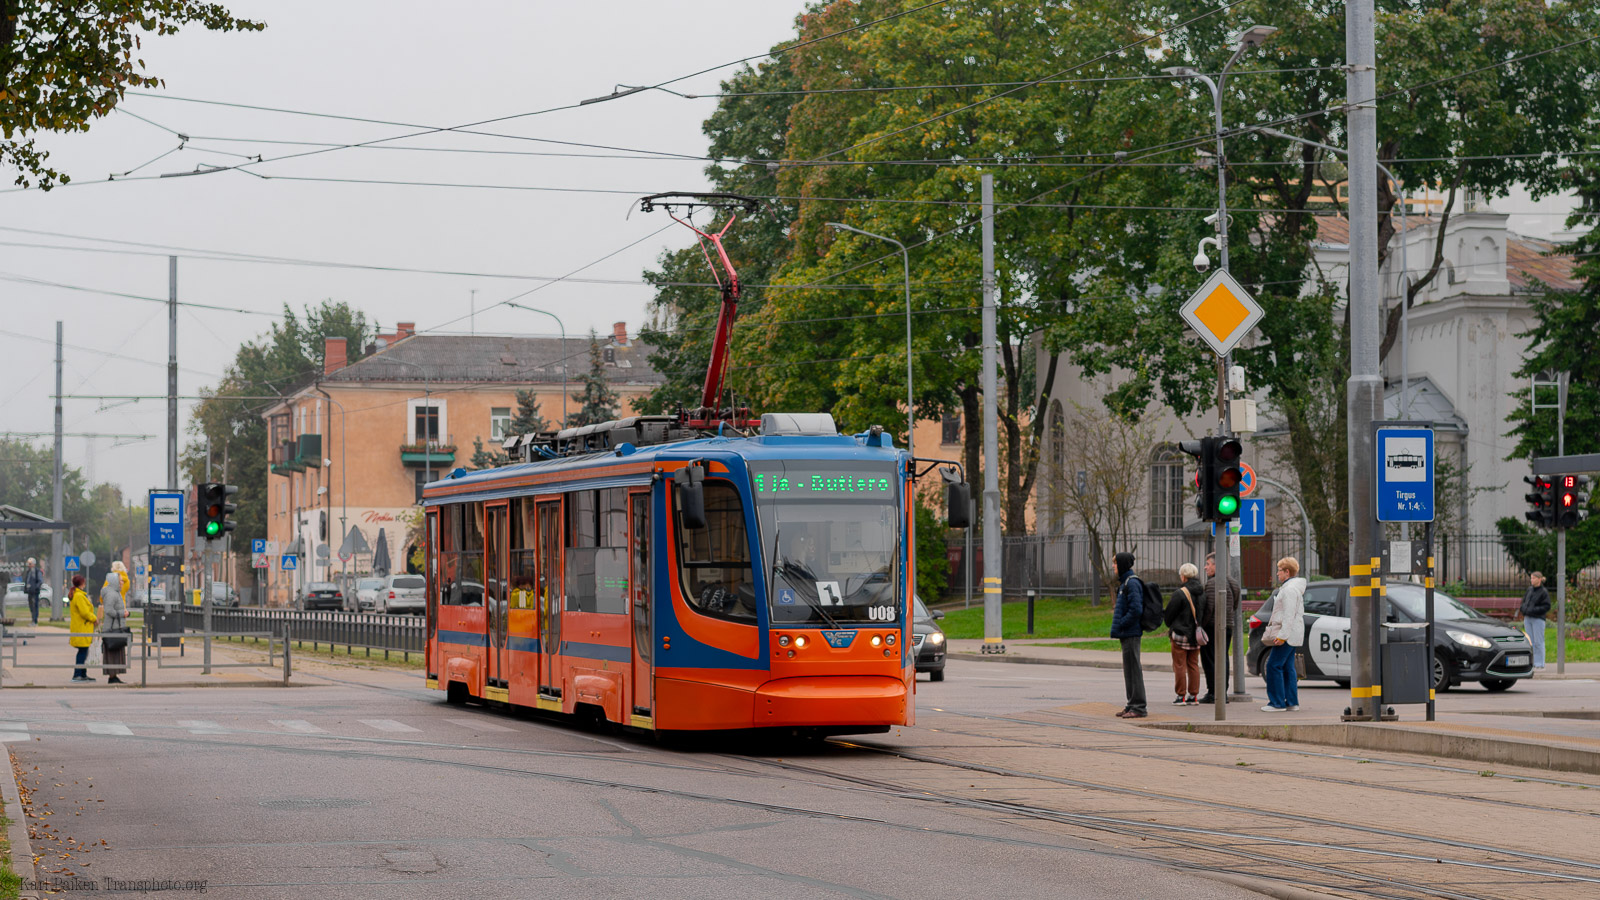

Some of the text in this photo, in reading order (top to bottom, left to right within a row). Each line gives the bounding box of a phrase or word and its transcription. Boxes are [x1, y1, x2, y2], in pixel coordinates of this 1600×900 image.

[754, 473, 764, 492] 1
[1564, 476, 1574, 487] 13
[1396, 490, 1416, 501] Tirgus
[1397, 502, 1407, 511] Nr.
[255, 541, 263, 552] P
